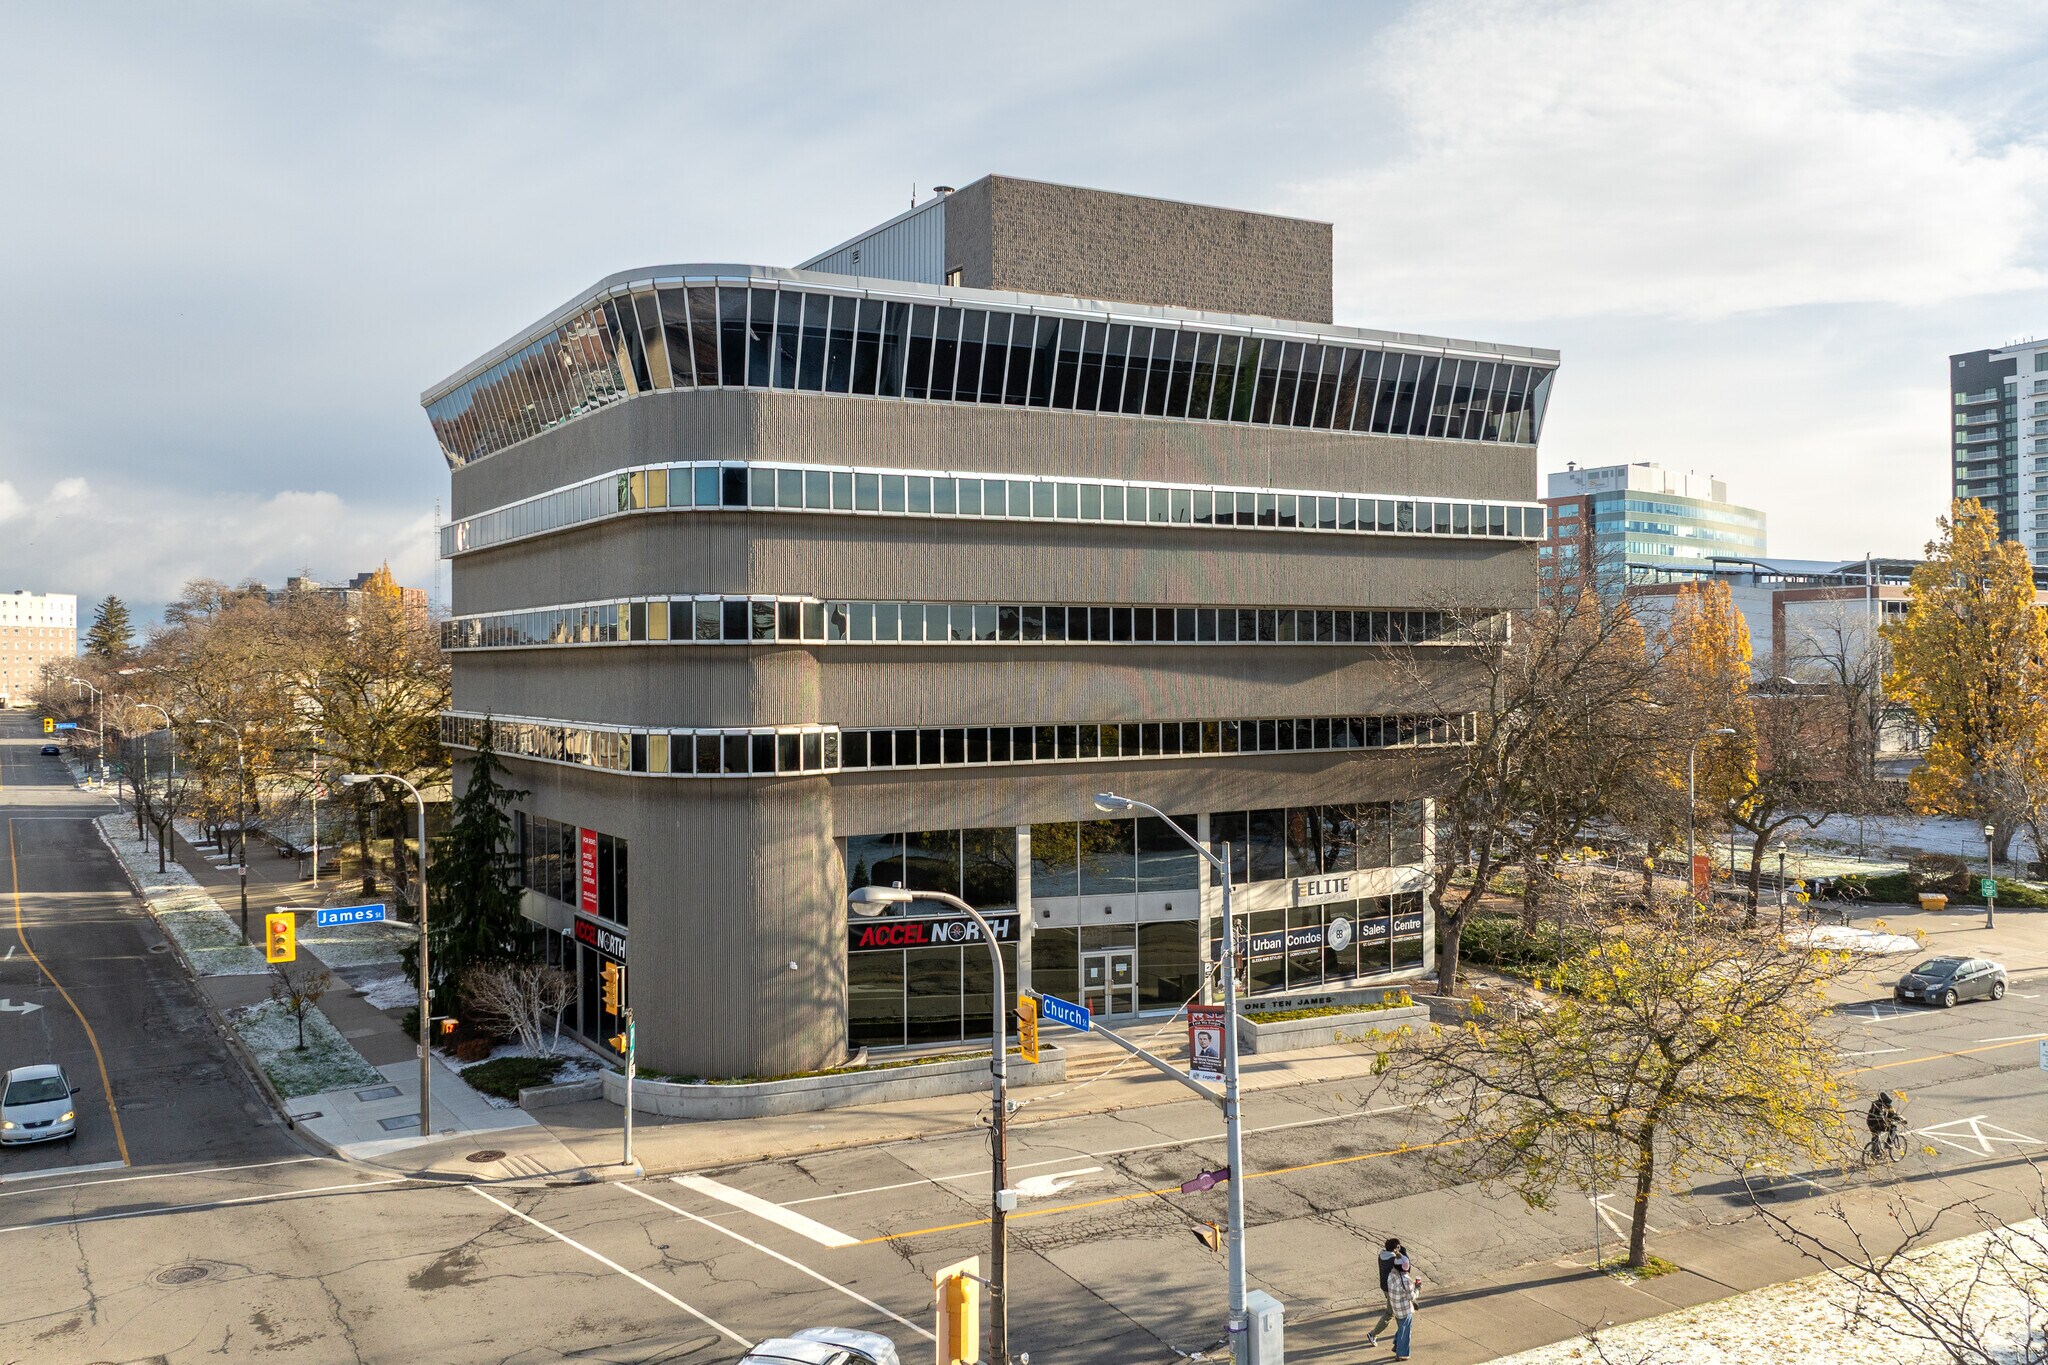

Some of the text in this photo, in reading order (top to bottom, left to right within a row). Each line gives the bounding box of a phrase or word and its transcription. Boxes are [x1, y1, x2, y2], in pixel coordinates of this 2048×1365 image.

[1308, 878, 1348, 895] ELITE
[320, 910, 373, 923] James
[859, 923, 929, 947] ACCEL
[1363, 920, 1421, 936] Sales Centre
[576, 921, 626, 959] ACCEL NORTH
[1253, 933, 1322, 951] Urban Condos
[1244, 996, 1332, 1010] ONE TEN JAMES
[1044, 999, 1082, 1025] Church
